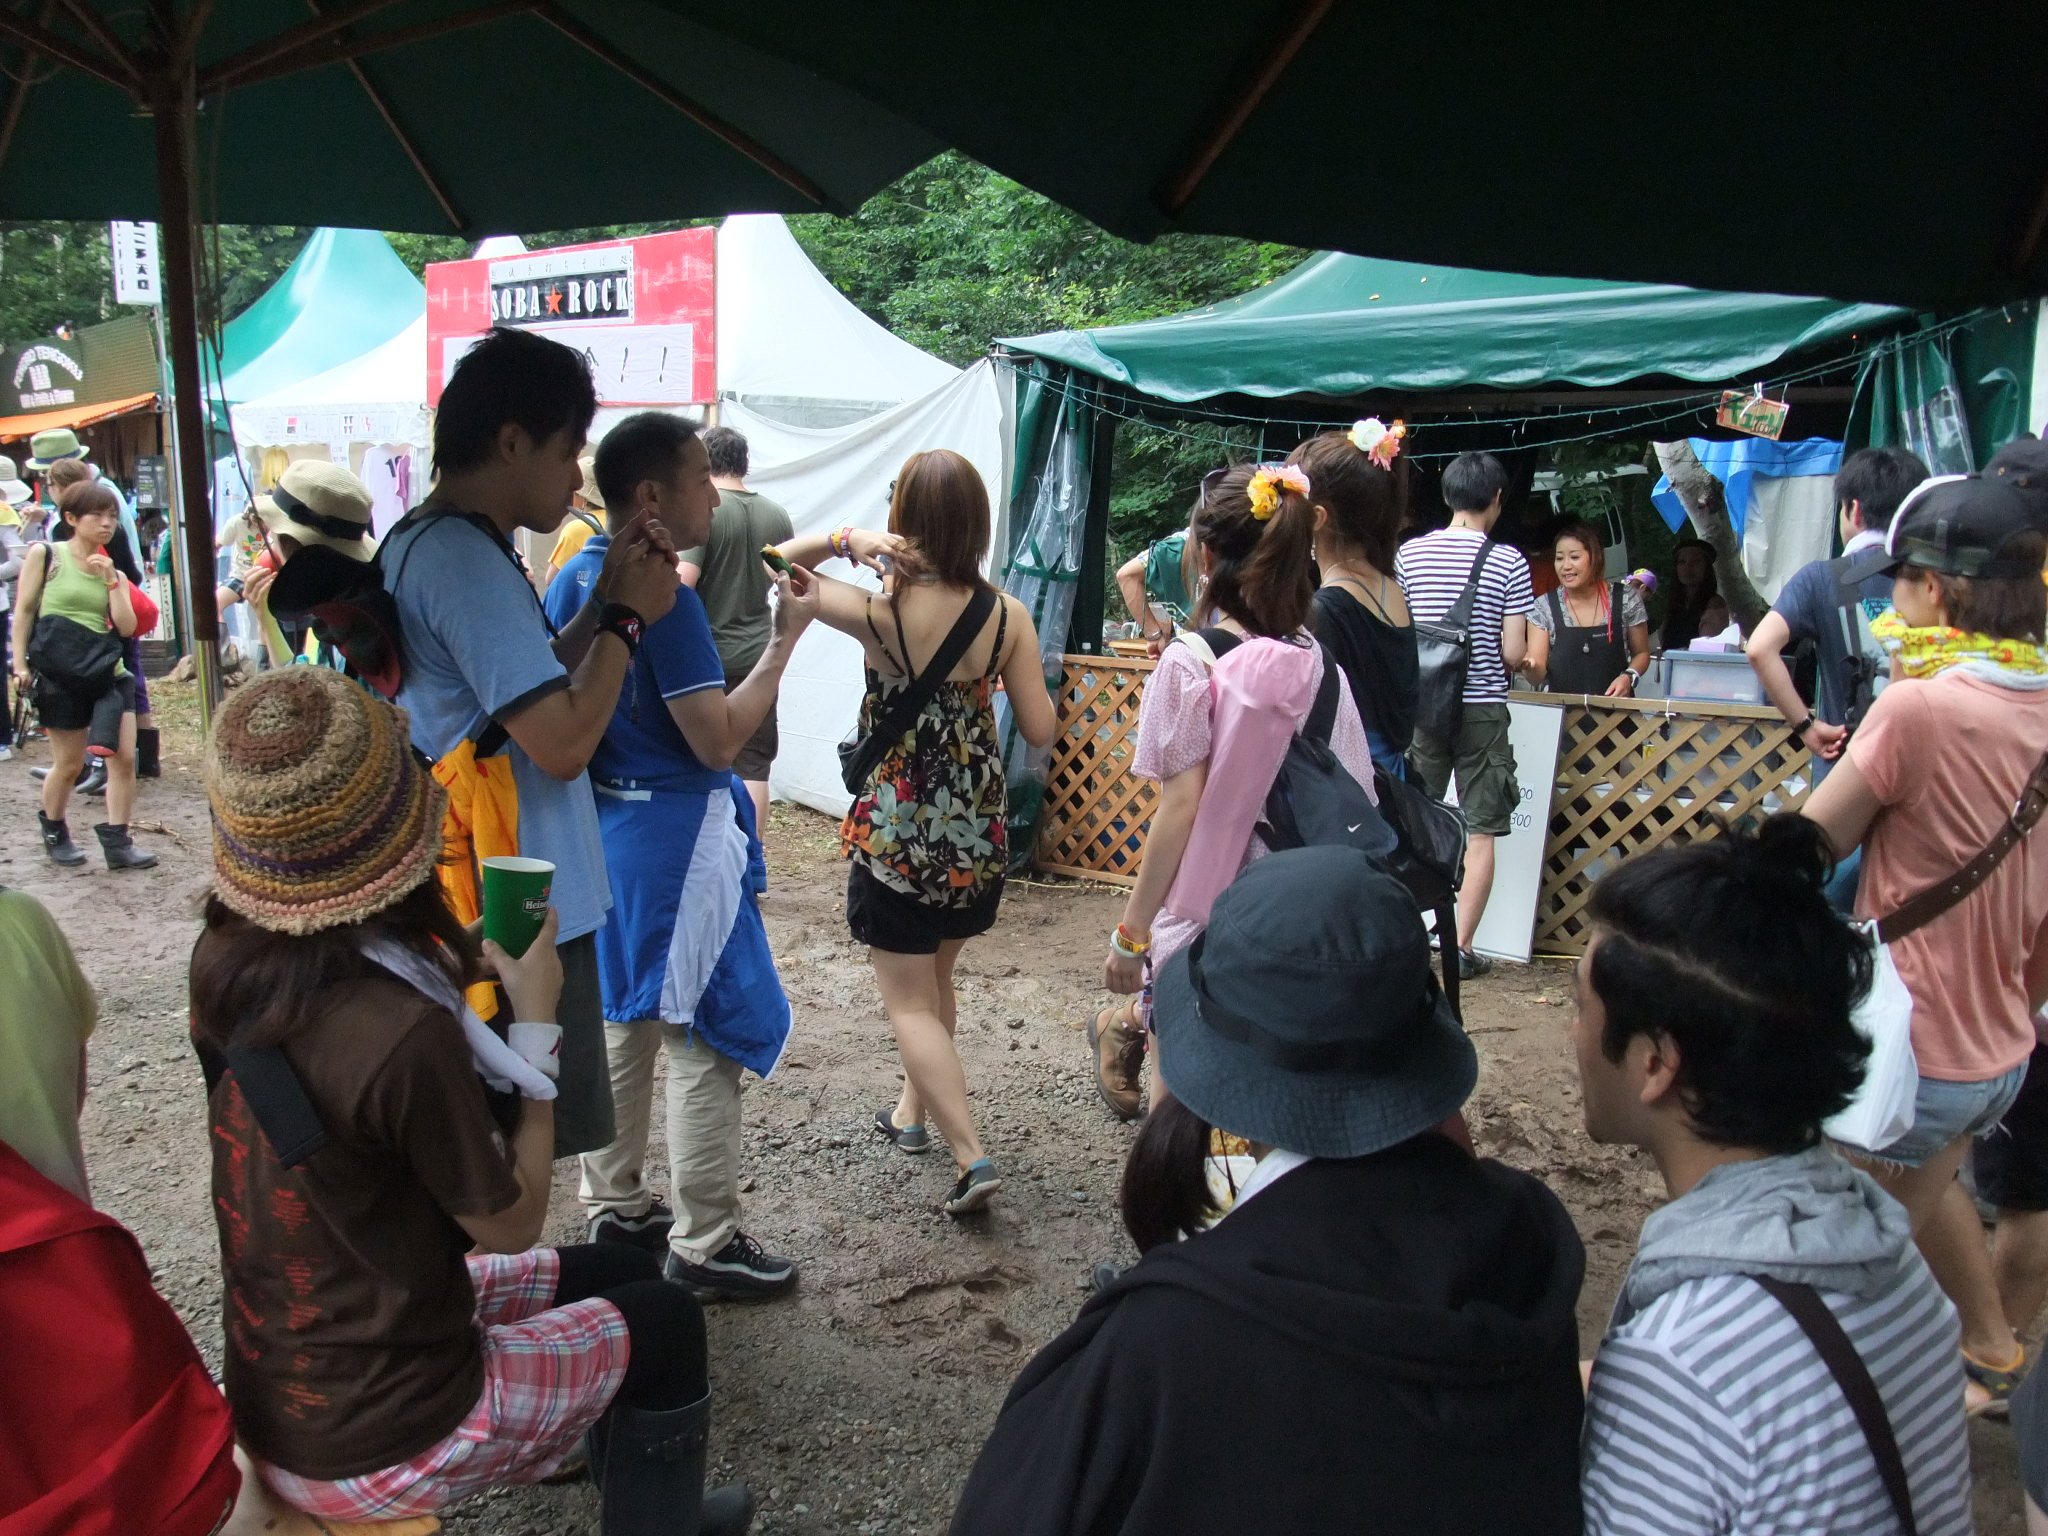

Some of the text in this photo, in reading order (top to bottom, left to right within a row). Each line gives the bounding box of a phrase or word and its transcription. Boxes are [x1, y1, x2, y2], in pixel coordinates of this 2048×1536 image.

[491, 286, 541, 321] SOBA
[568, 277, 629, 314] ROCK
[1519, 787, 1533, 800] 00
[1510, 812, 1532, 827] 300
